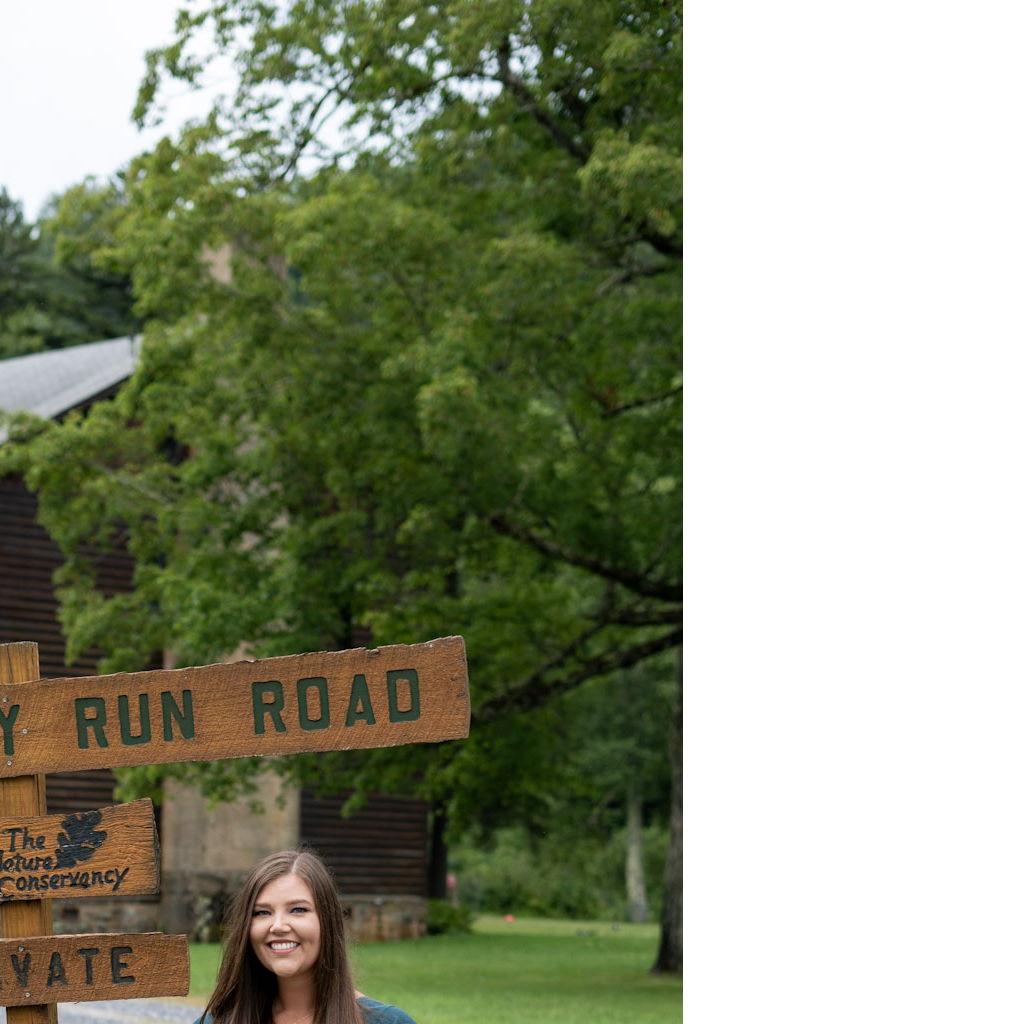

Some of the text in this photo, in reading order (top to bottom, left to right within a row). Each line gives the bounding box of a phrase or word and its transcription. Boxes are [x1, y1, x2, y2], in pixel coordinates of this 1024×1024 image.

[75, 689, 195, 749] RUN
[251, 668, 421, 736] ROAD
[2, 827, 46, 852] The
